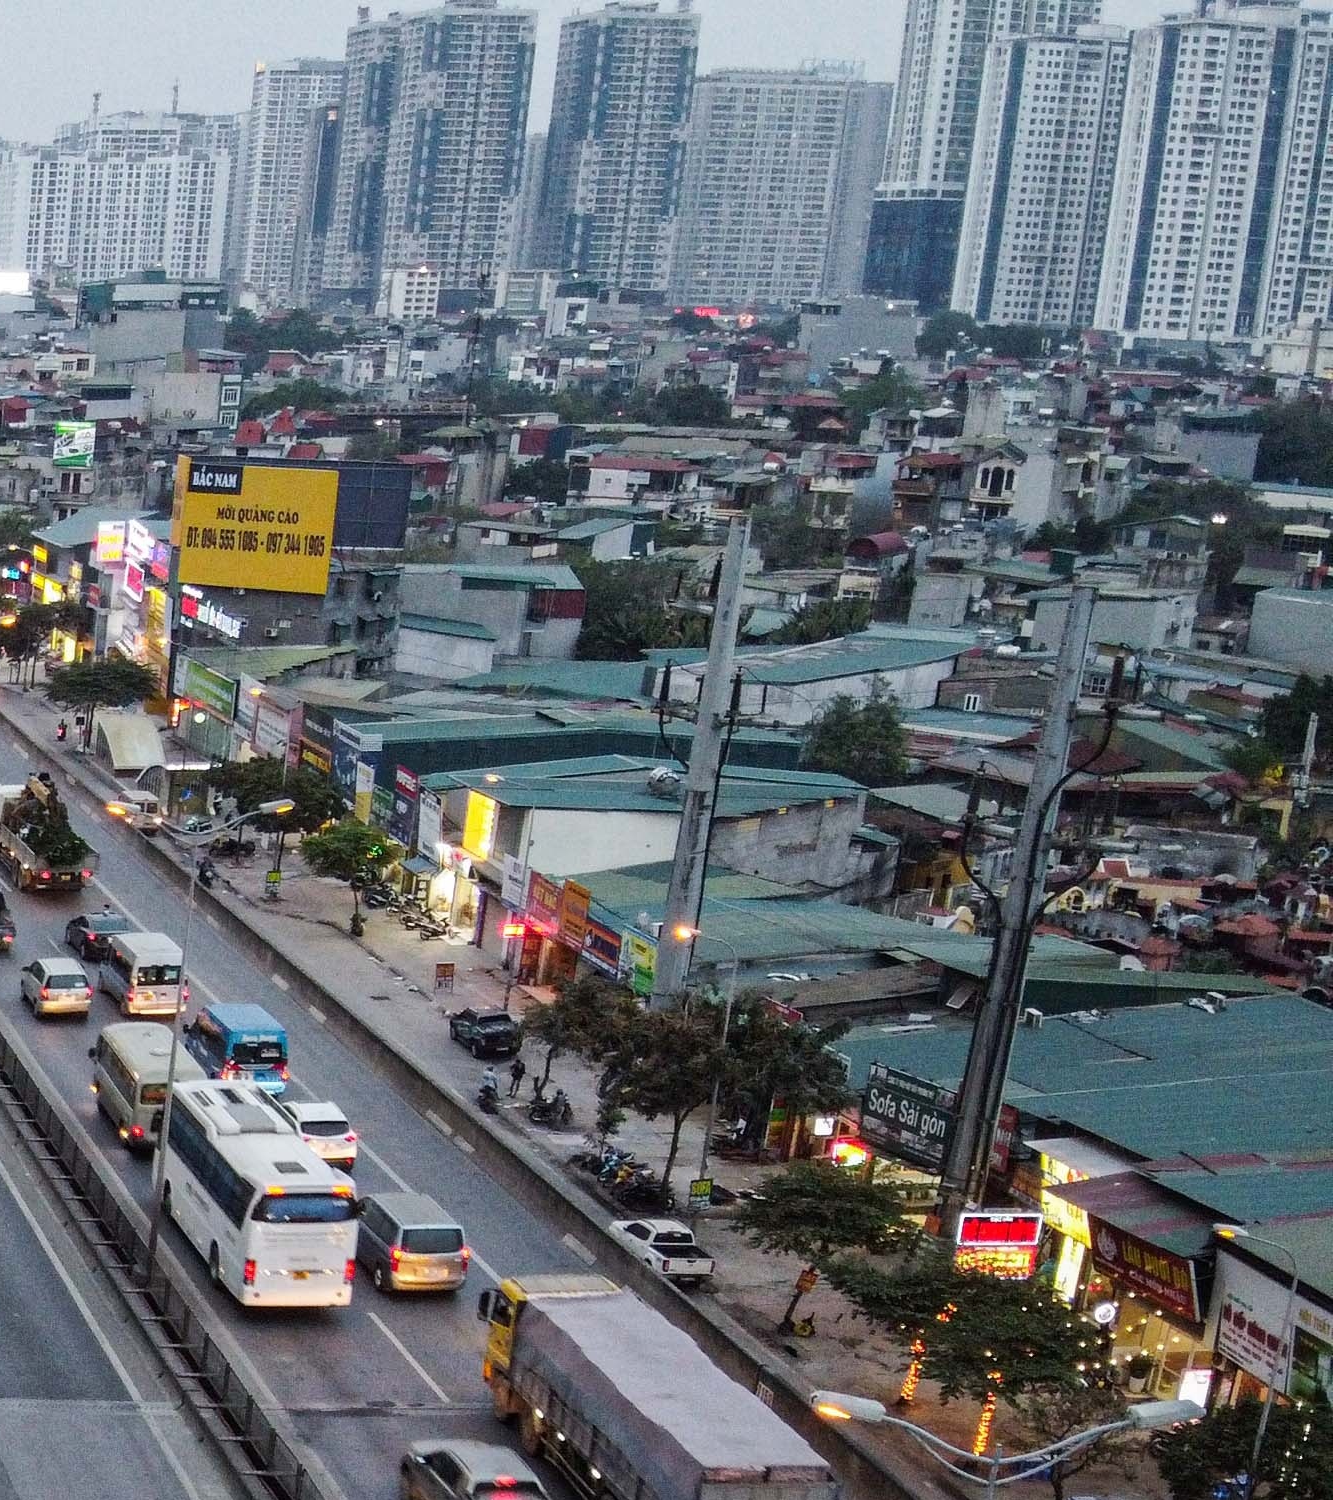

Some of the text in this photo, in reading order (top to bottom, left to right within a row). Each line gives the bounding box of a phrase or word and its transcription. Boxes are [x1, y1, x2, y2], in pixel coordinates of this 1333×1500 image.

[192, 466, 237, 488] BẮC NAM
[201, 527, 217, 549] 094
[219, 528, 235, 551] 555
[266, 532, 283, 554] 097
[285, 533, 301, 555] 344
[868, 1088, 946, 1138] Sofa Sài gòn
